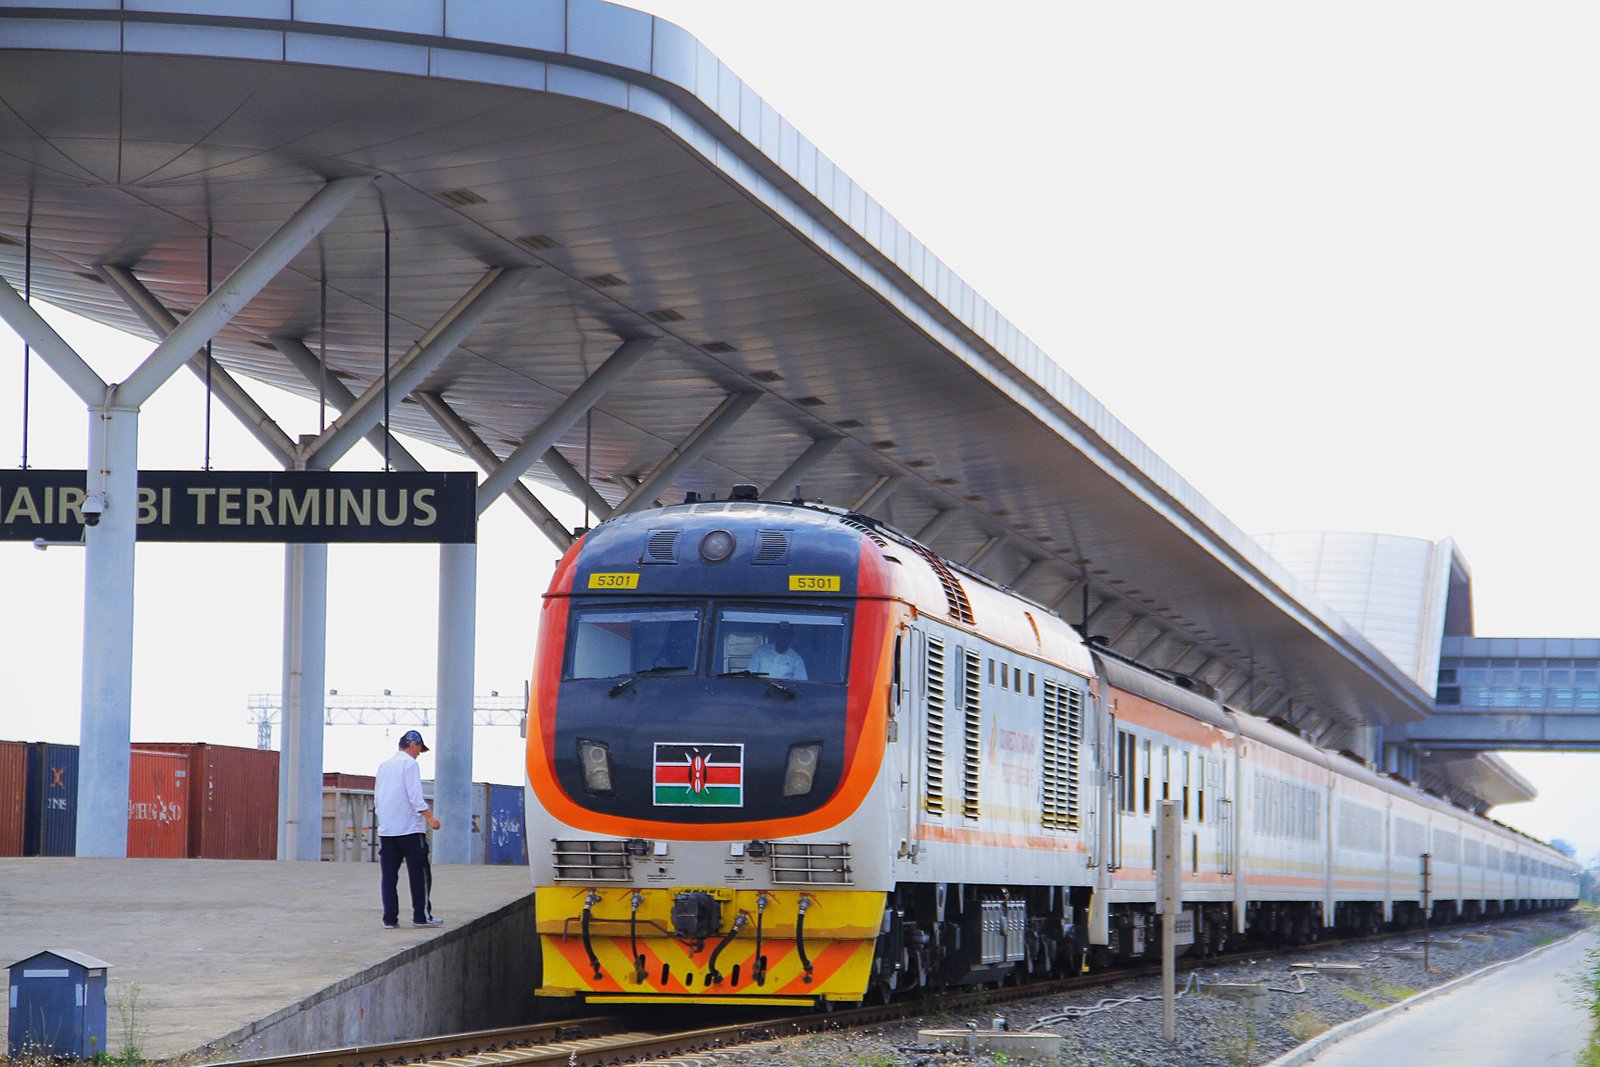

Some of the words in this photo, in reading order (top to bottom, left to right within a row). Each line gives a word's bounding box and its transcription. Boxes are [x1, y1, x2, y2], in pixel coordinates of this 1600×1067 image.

[0, 486, 171, 525] AIRBI
[186, 488, 437, 526] TERMINUS
[598, 575, 630, 586] 5301
[798, 578, 831, 589] 5301
